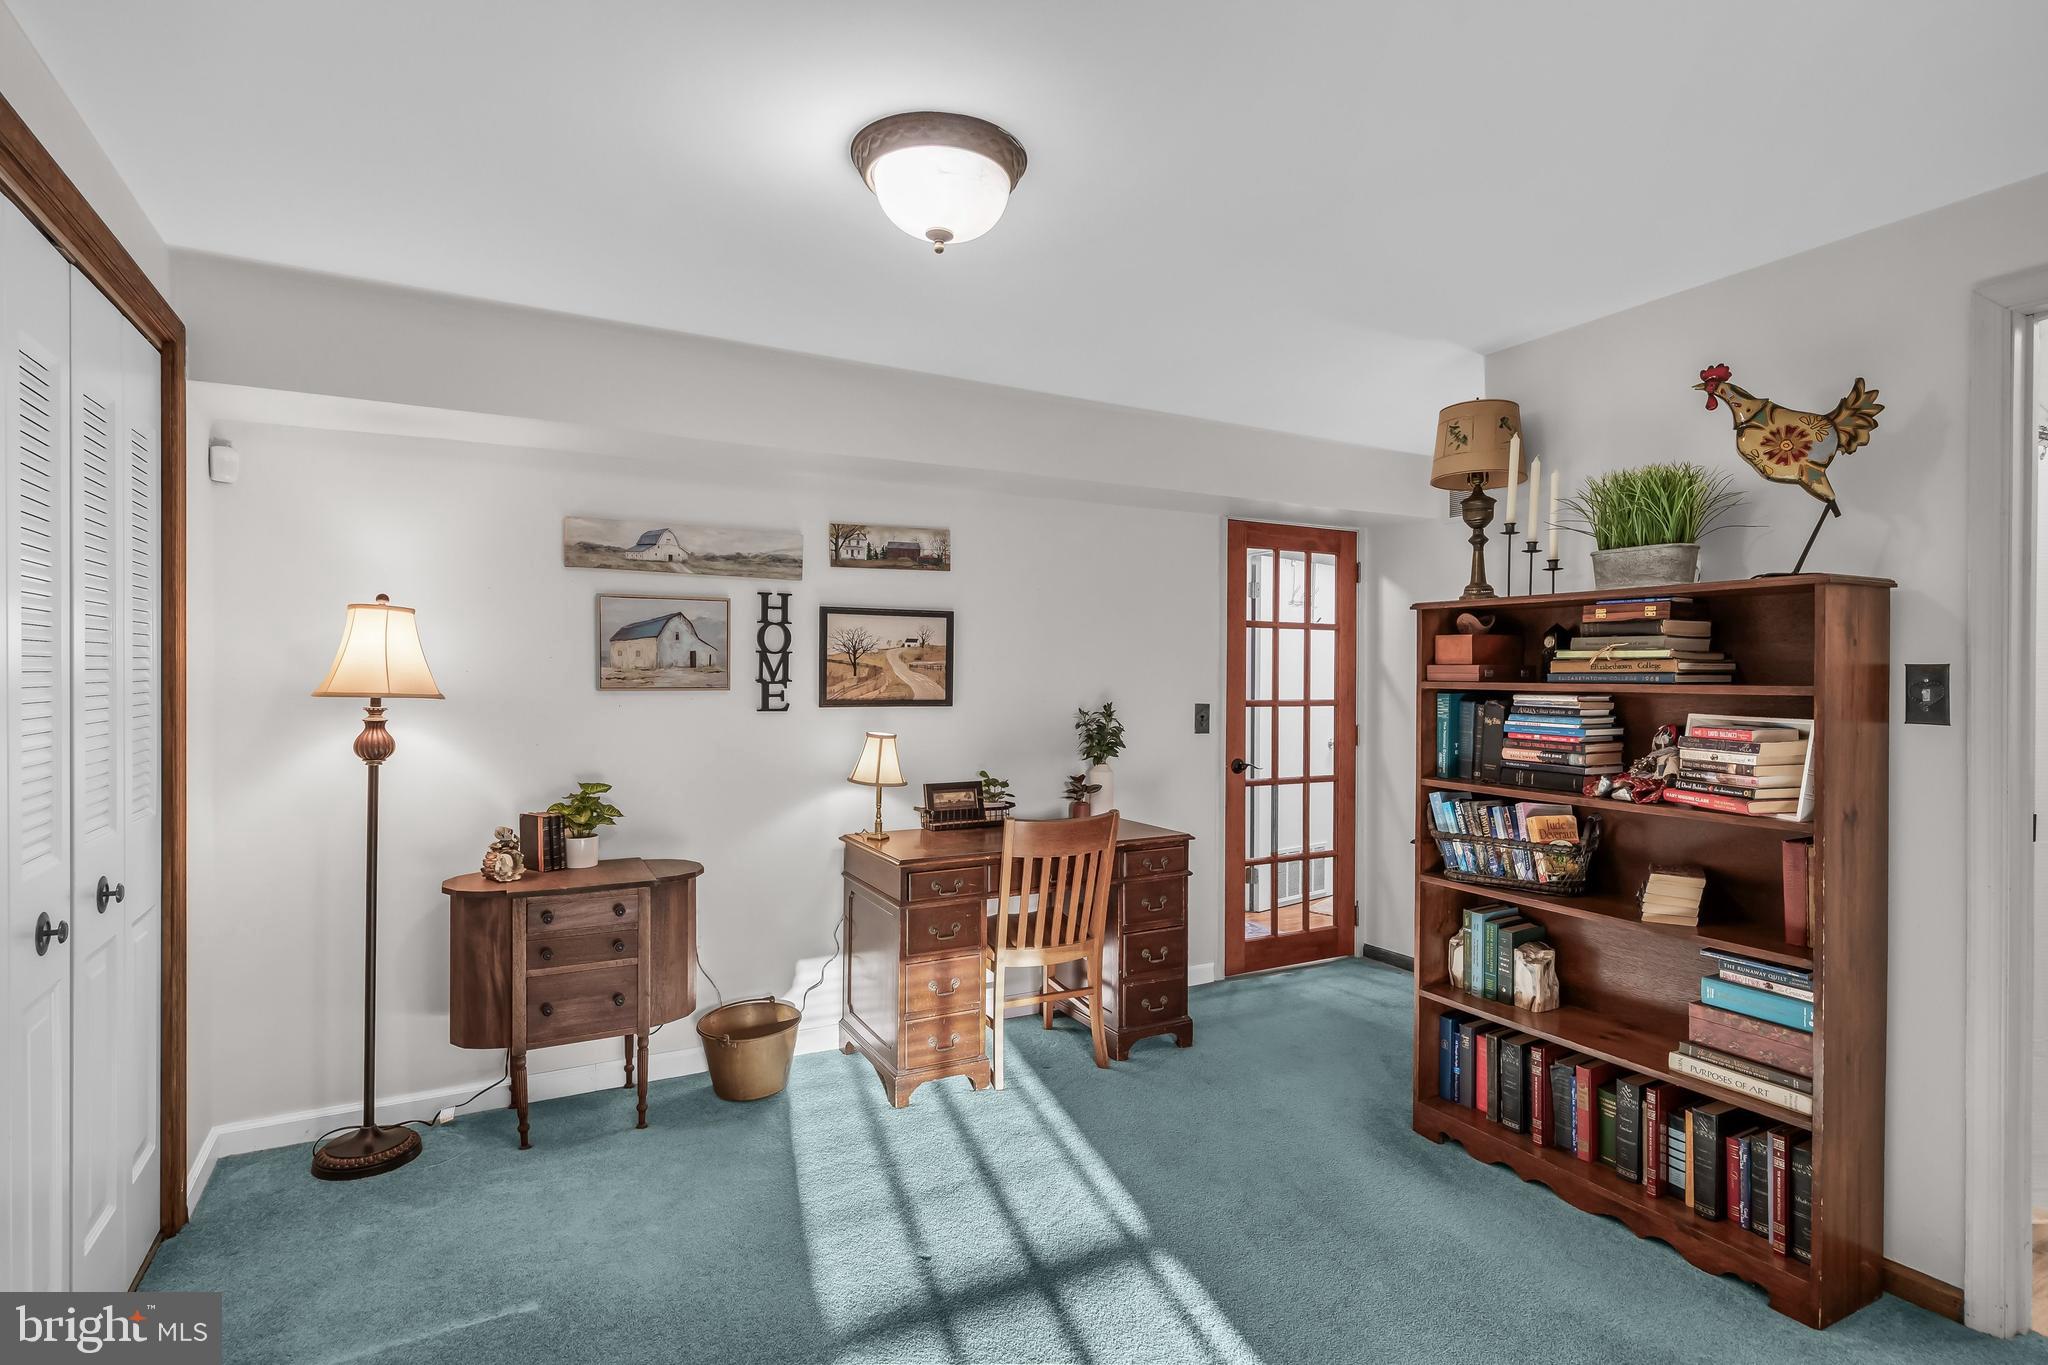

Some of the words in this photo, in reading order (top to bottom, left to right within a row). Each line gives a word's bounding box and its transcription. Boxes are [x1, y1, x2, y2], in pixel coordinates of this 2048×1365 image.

[756, 591, 793, 712] HOME
[1590, 662, 1632, 671] Elizabethtown
[1637, 662, 1661, 672] College
[1546, 819, 1566, 830] Jude
[1539, 829, 1576, 839] Deveraux
[1737, 966, 1766, 978] RUNAWAY
[1768, 973, 1787, 982] QUILT
[1690, 1065, 1732, 1084] PURPOSES
[1735, 1081, 1746, 1090] OF
[1749, 1086, 1769, 1097] ART
